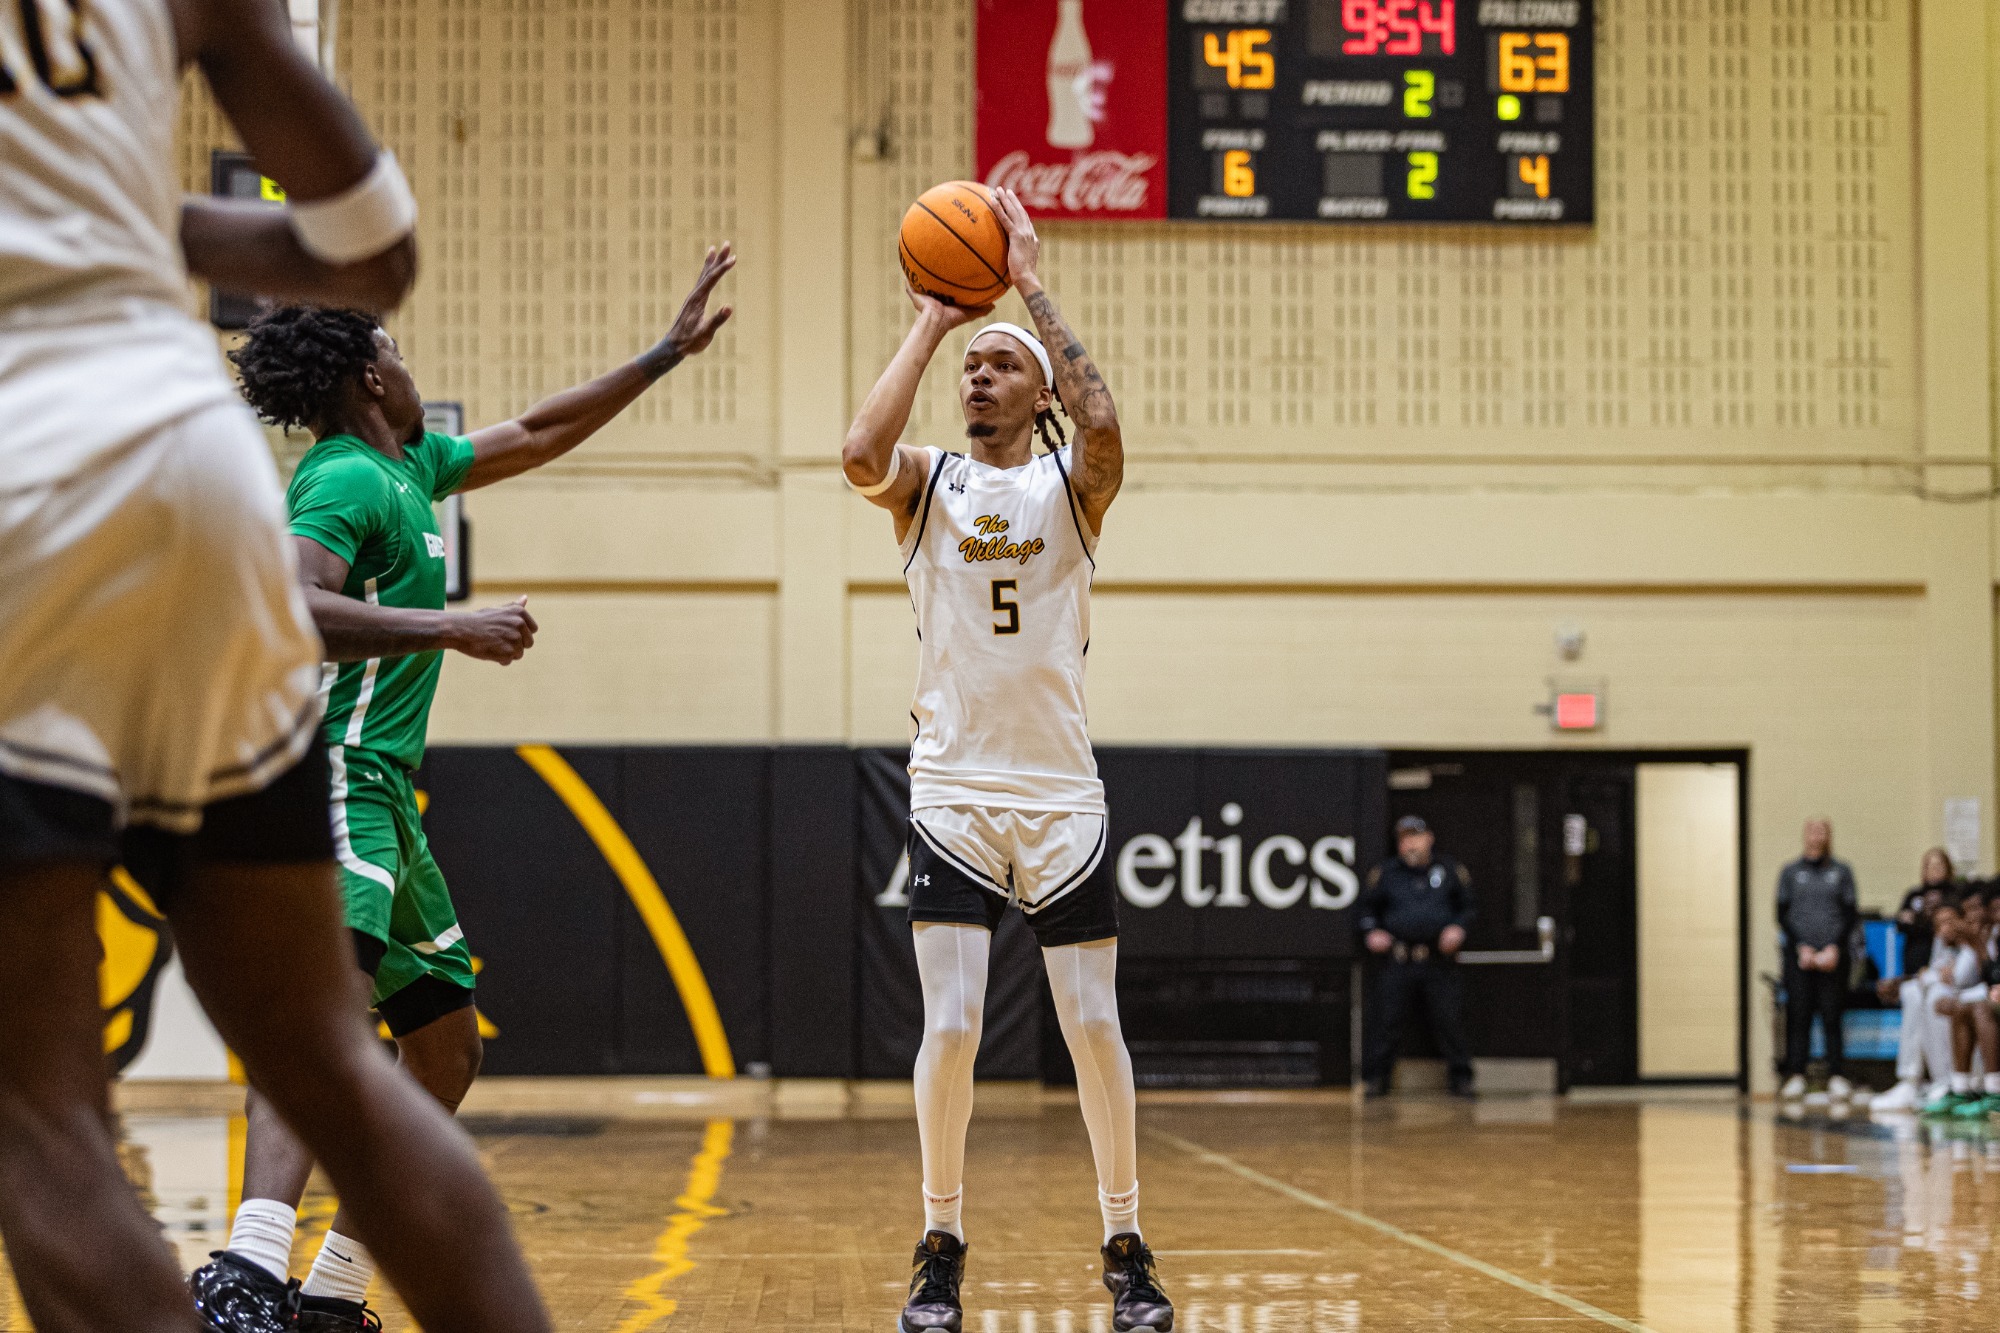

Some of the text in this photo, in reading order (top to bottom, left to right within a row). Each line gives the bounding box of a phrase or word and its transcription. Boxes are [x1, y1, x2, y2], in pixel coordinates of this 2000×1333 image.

[1341, 0, 1456, 56] 9:54
[1203, 29, 1275, 90] 45
[1499, 32, 1570, 93] 63
[1302, 69, 1435, 118] PERIOD 2
[1223, 150, 1255, 198] 6
[1406, 151, 1439, 200] 2
[1518, 153, 1550, 199] 4
[974, 514, 1010, 536] The
[958, 535, 1045, 565] Village
[990, 578, 1021, 636] 5
